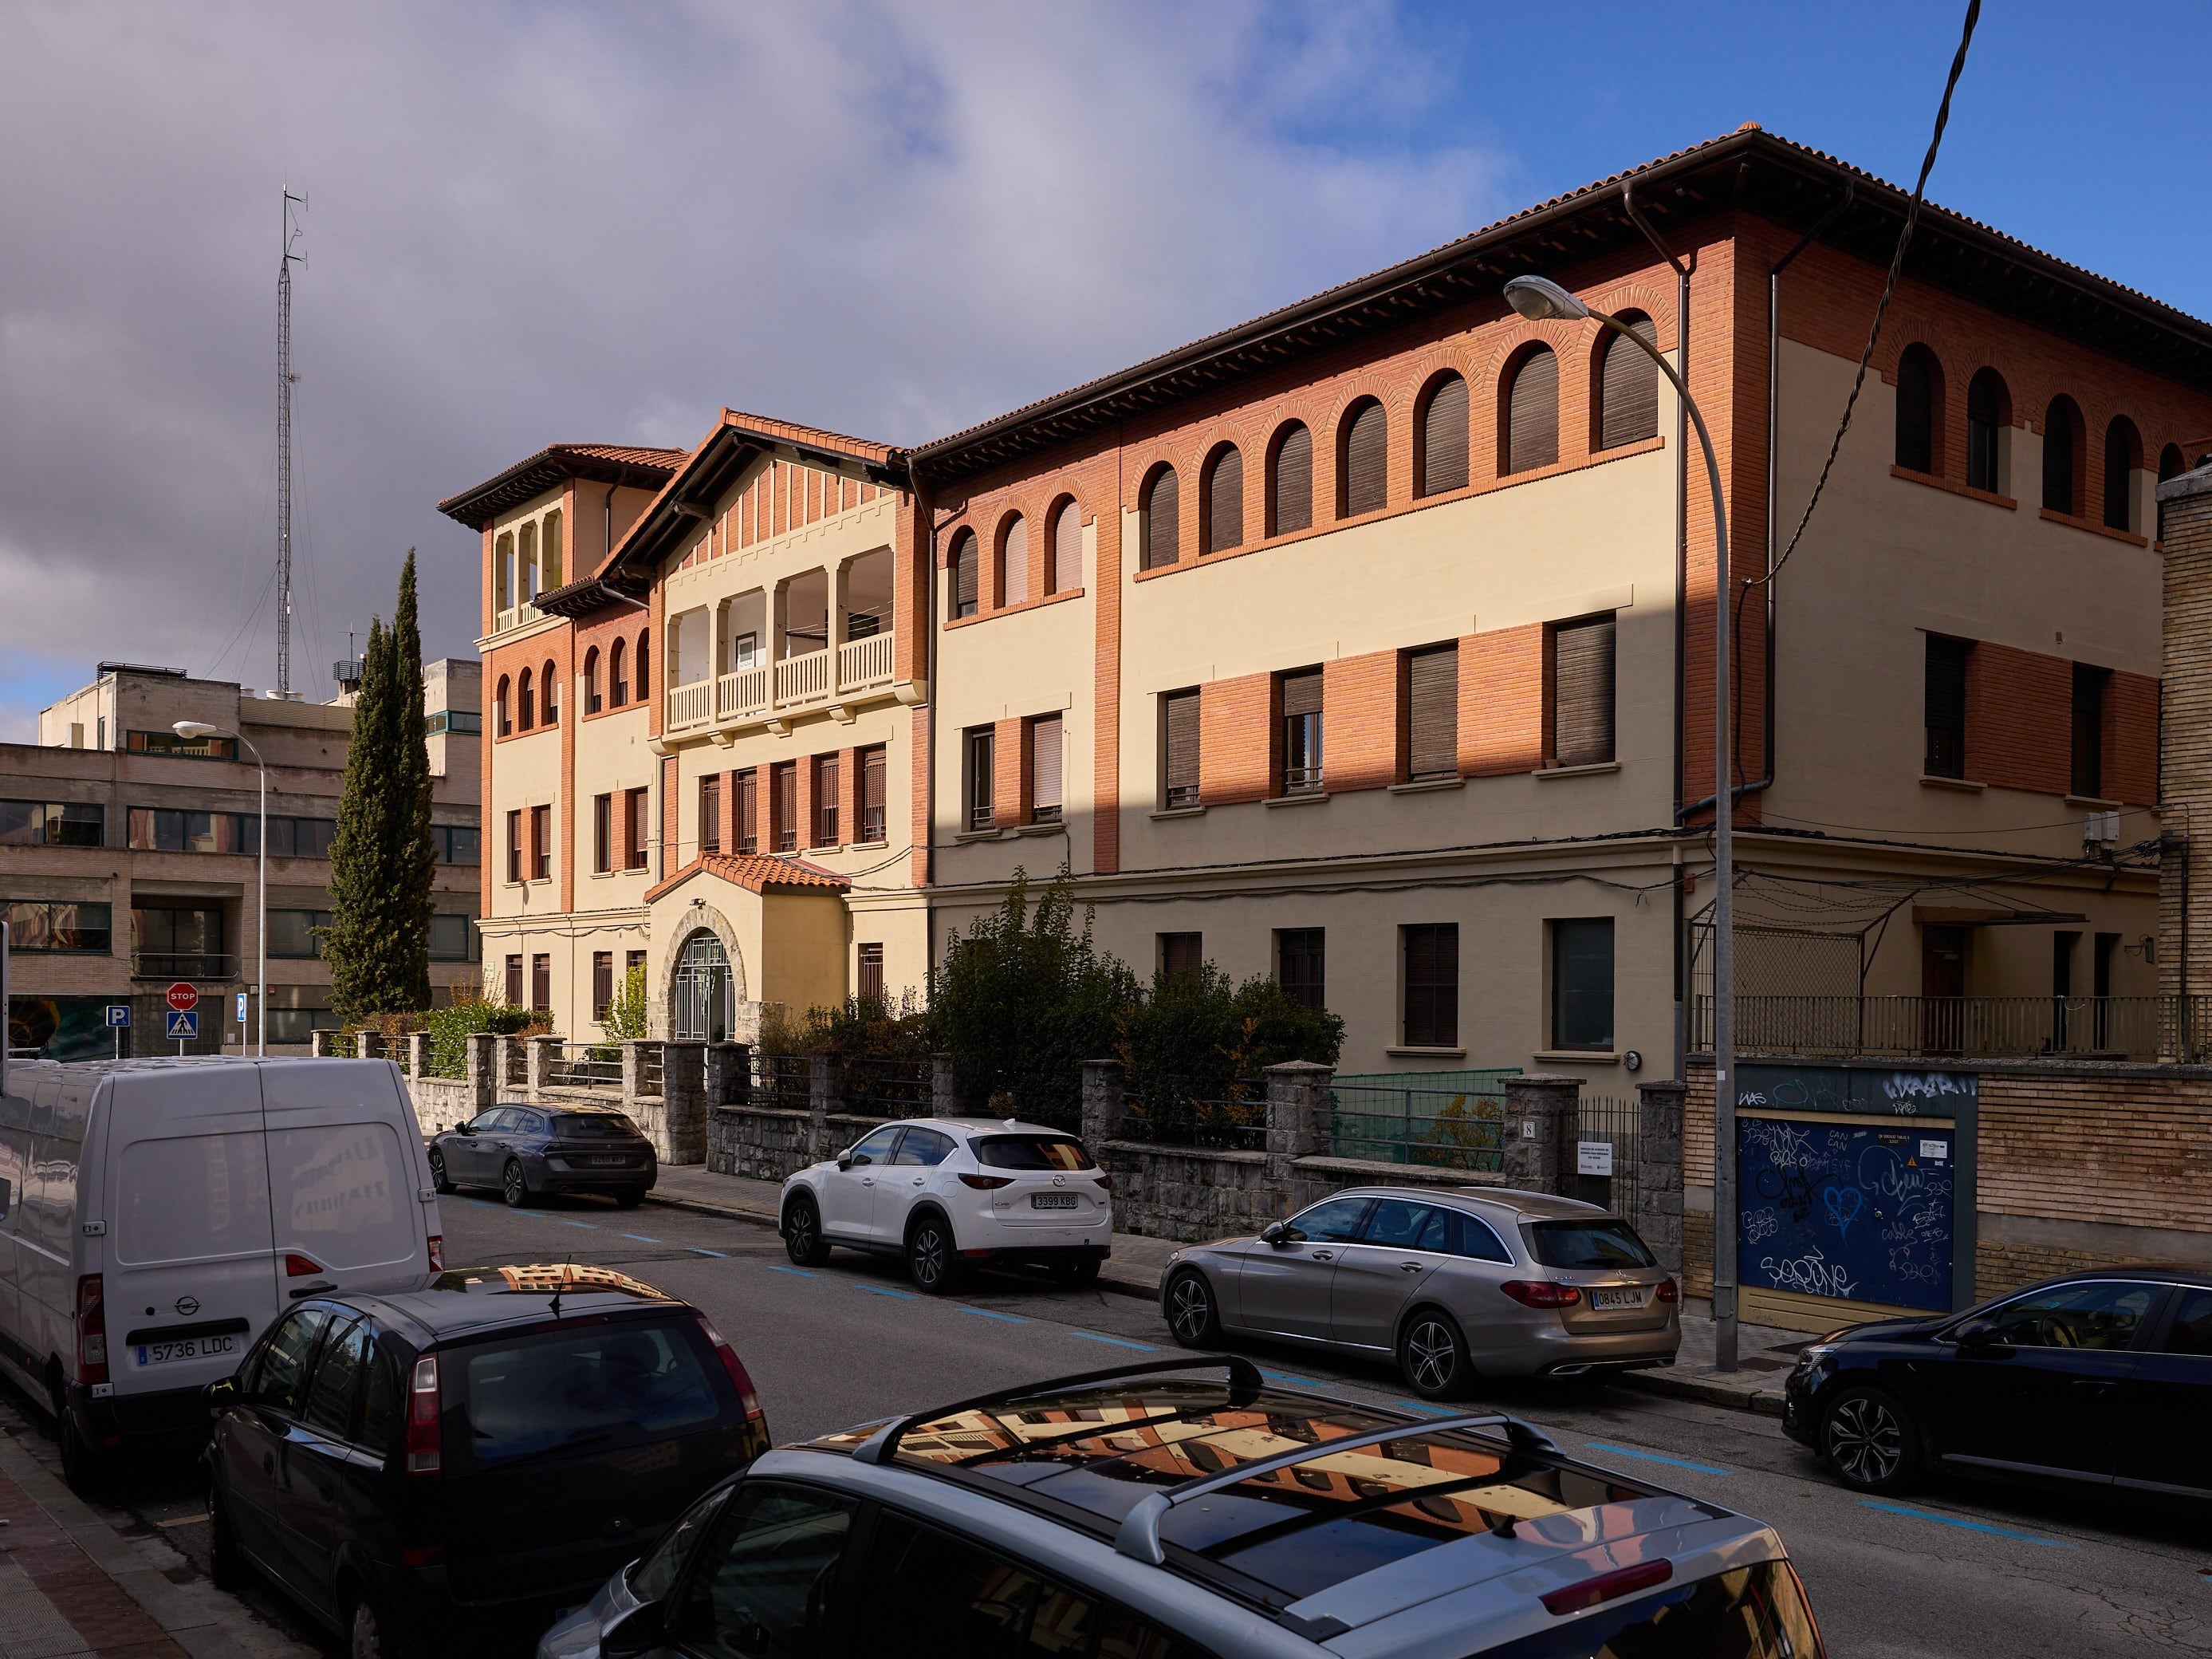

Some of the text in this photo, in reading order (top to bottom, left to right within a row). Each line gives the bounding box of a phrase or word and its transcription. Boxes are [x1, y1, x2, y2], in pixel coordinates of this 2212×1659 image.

[112, 1008, 125, 1024] P
[1526, 1124, 1532, 1135] 8
[1829, 1129, 1848, 1141] CAN
[1828, 1137, 1848, 1152] CAN
[1037, 1196, 1076, 1206] 3399 KBG
[1598, 1291, 1643, 1305] 0845 LJM
[152, 1337, 233, 1361] 5736 LDC
